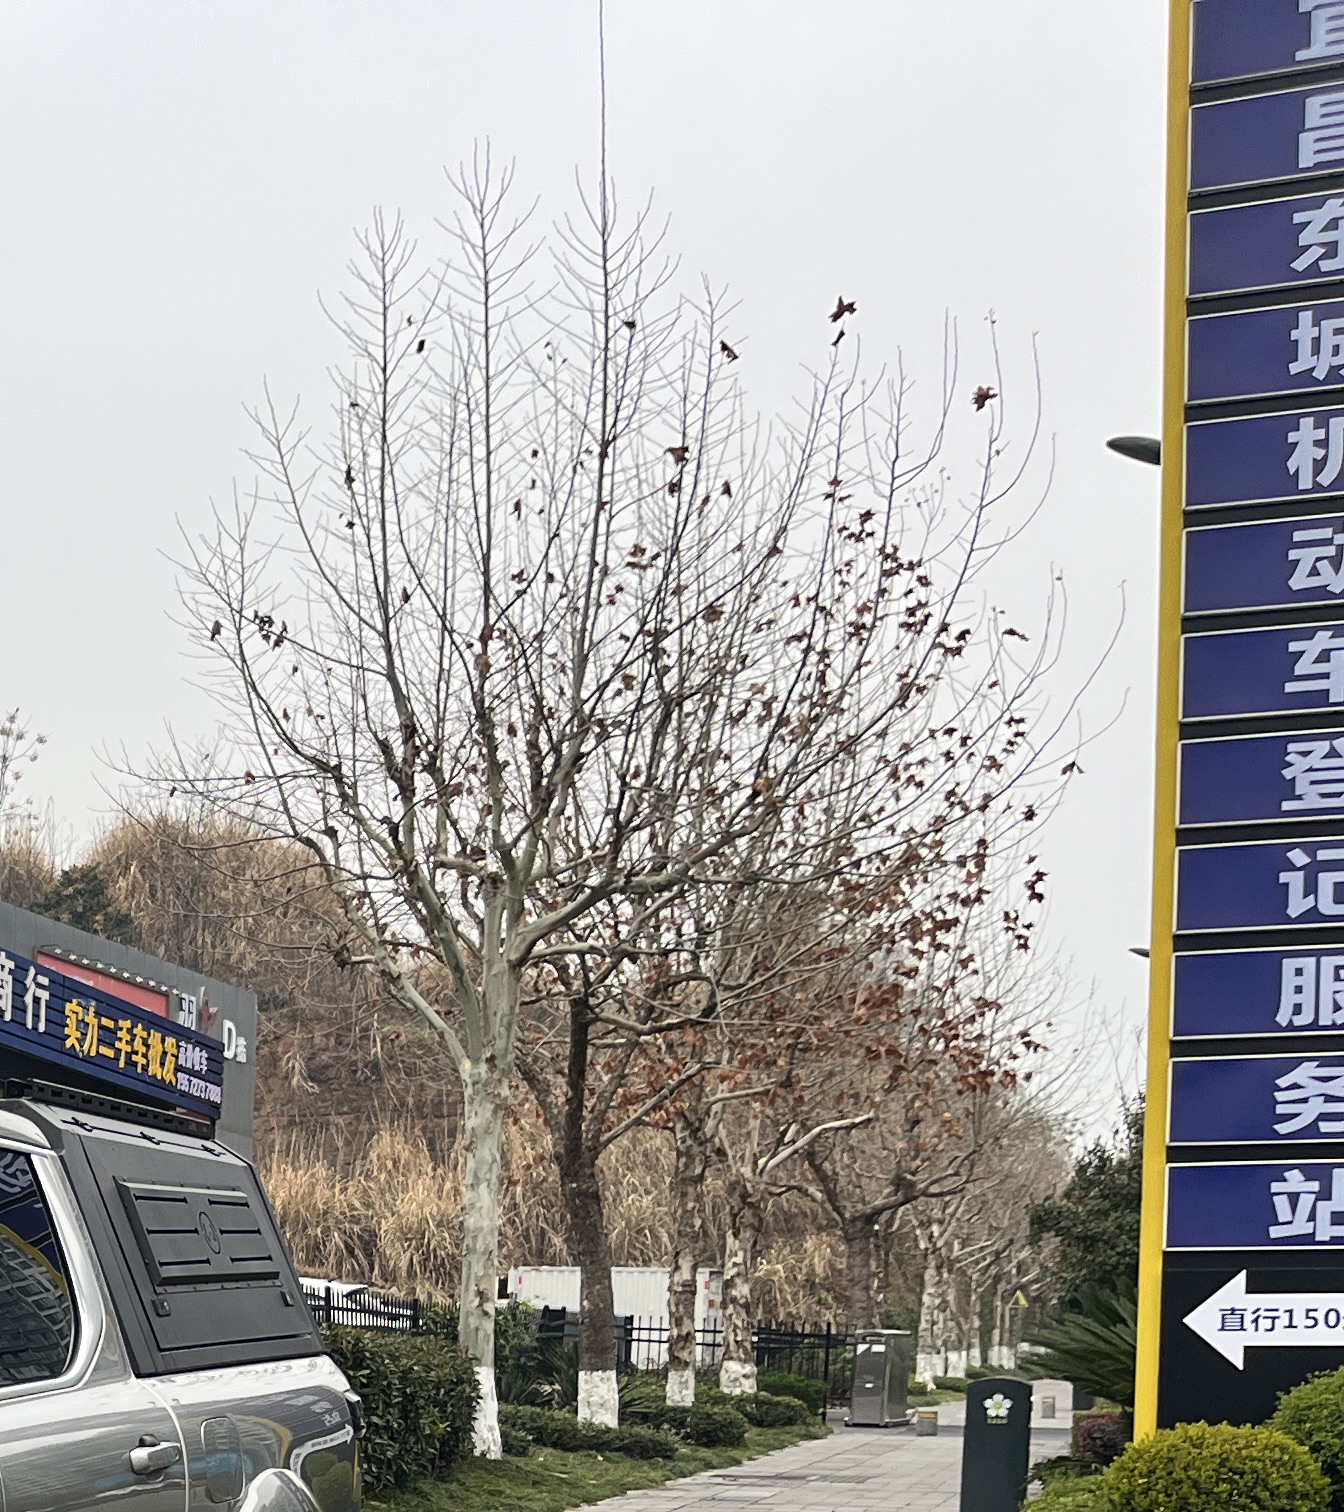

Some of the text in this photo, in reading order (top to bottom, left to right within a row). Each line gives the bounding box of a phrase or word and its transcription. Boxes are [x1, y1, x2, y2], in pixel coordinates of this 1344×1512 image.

[64, 998, 178, 1087] 实力二手车批发
[1216, 1306, 1344, 1333] 直行150
